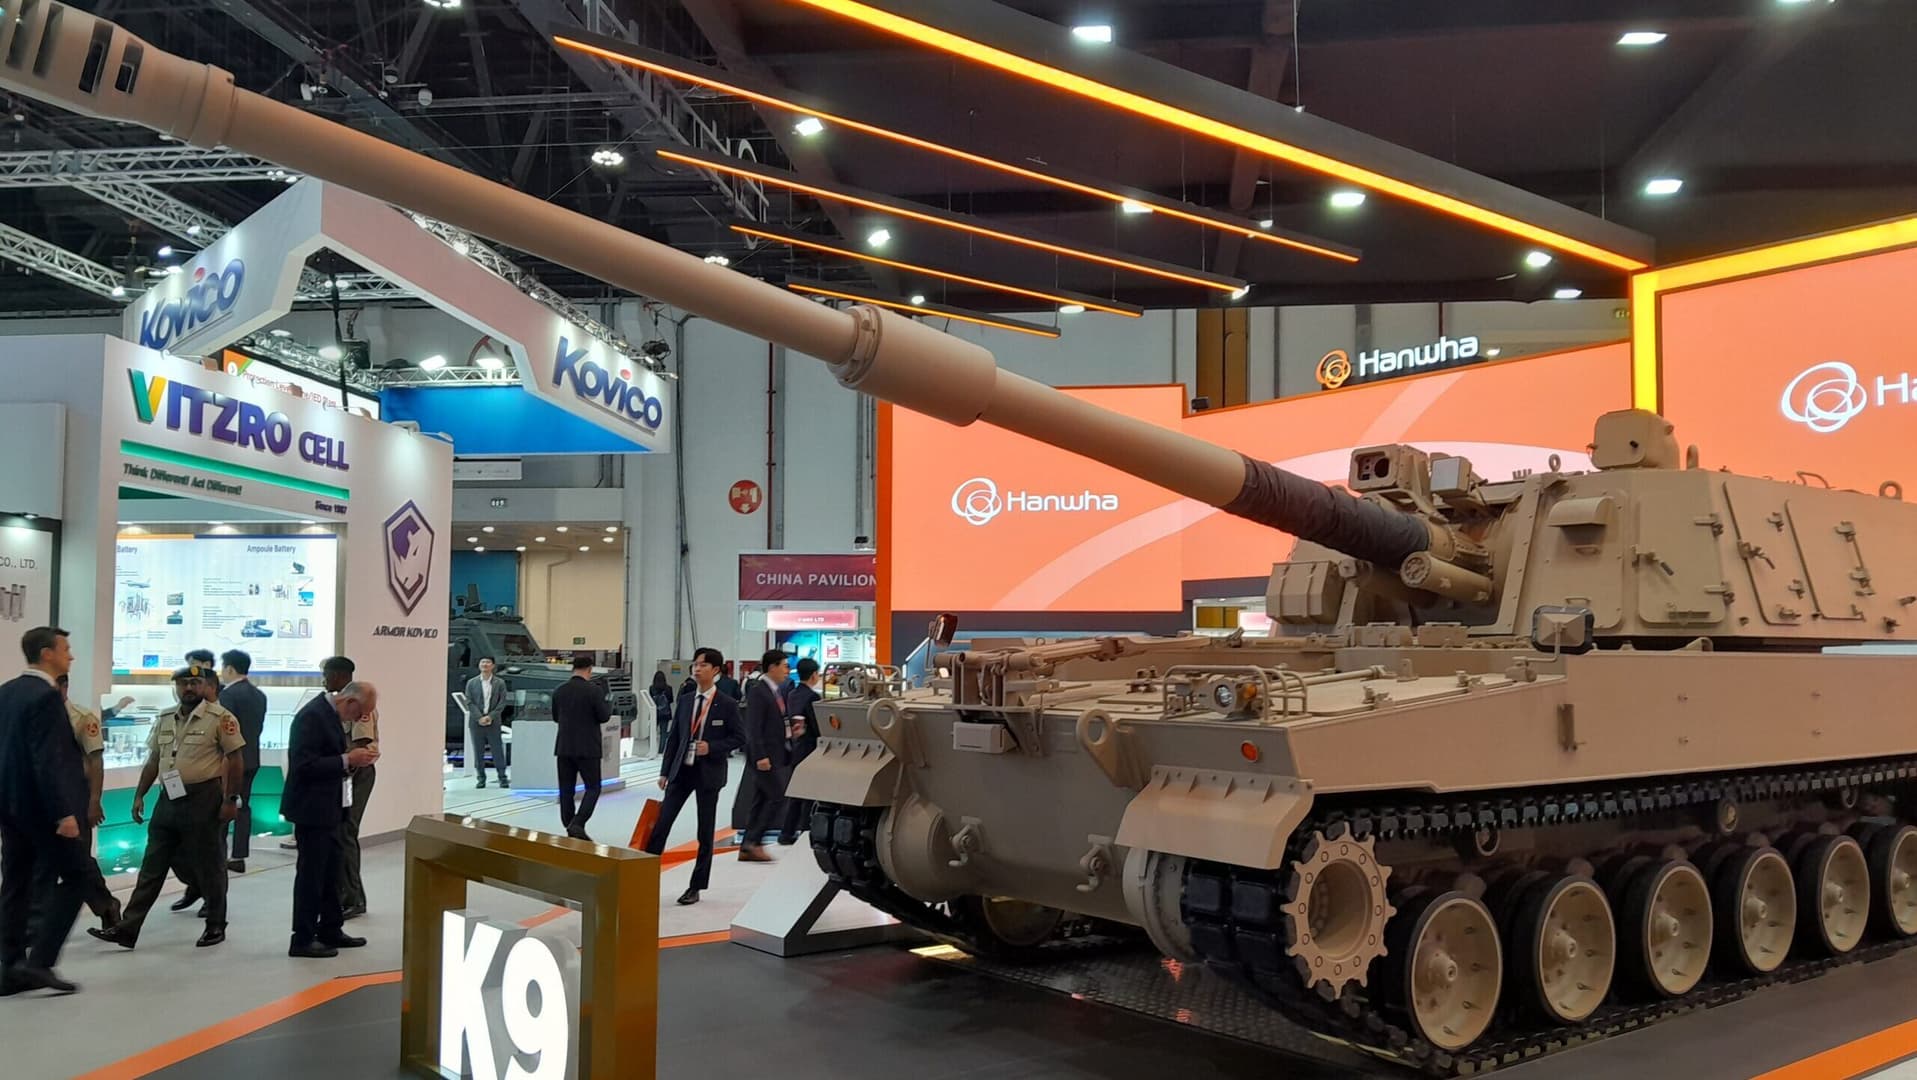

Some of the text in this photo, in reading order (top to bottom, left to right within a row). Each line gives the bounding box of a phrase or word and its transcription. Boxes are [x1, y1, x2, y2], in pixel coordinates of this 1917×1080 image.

[1359, 336, 1479, 377] Hanwha
[128, 368, 349, 471] VITZRO CELL
[123, 463, 148, 478] Think
[191, 476, 205, 488] Act
[315, 500, 332, 512] Since
[1007, 490, 1119, 512] Hanwha
[117, 545, 138, 555] Battery
[247, 545, 297, 554] Ampoule Battery
[756, 573, 803, 585] CHINA
[373, 625, 439, 639] ARMOR KOVICO
[438, 908, 570, 1080] K9
